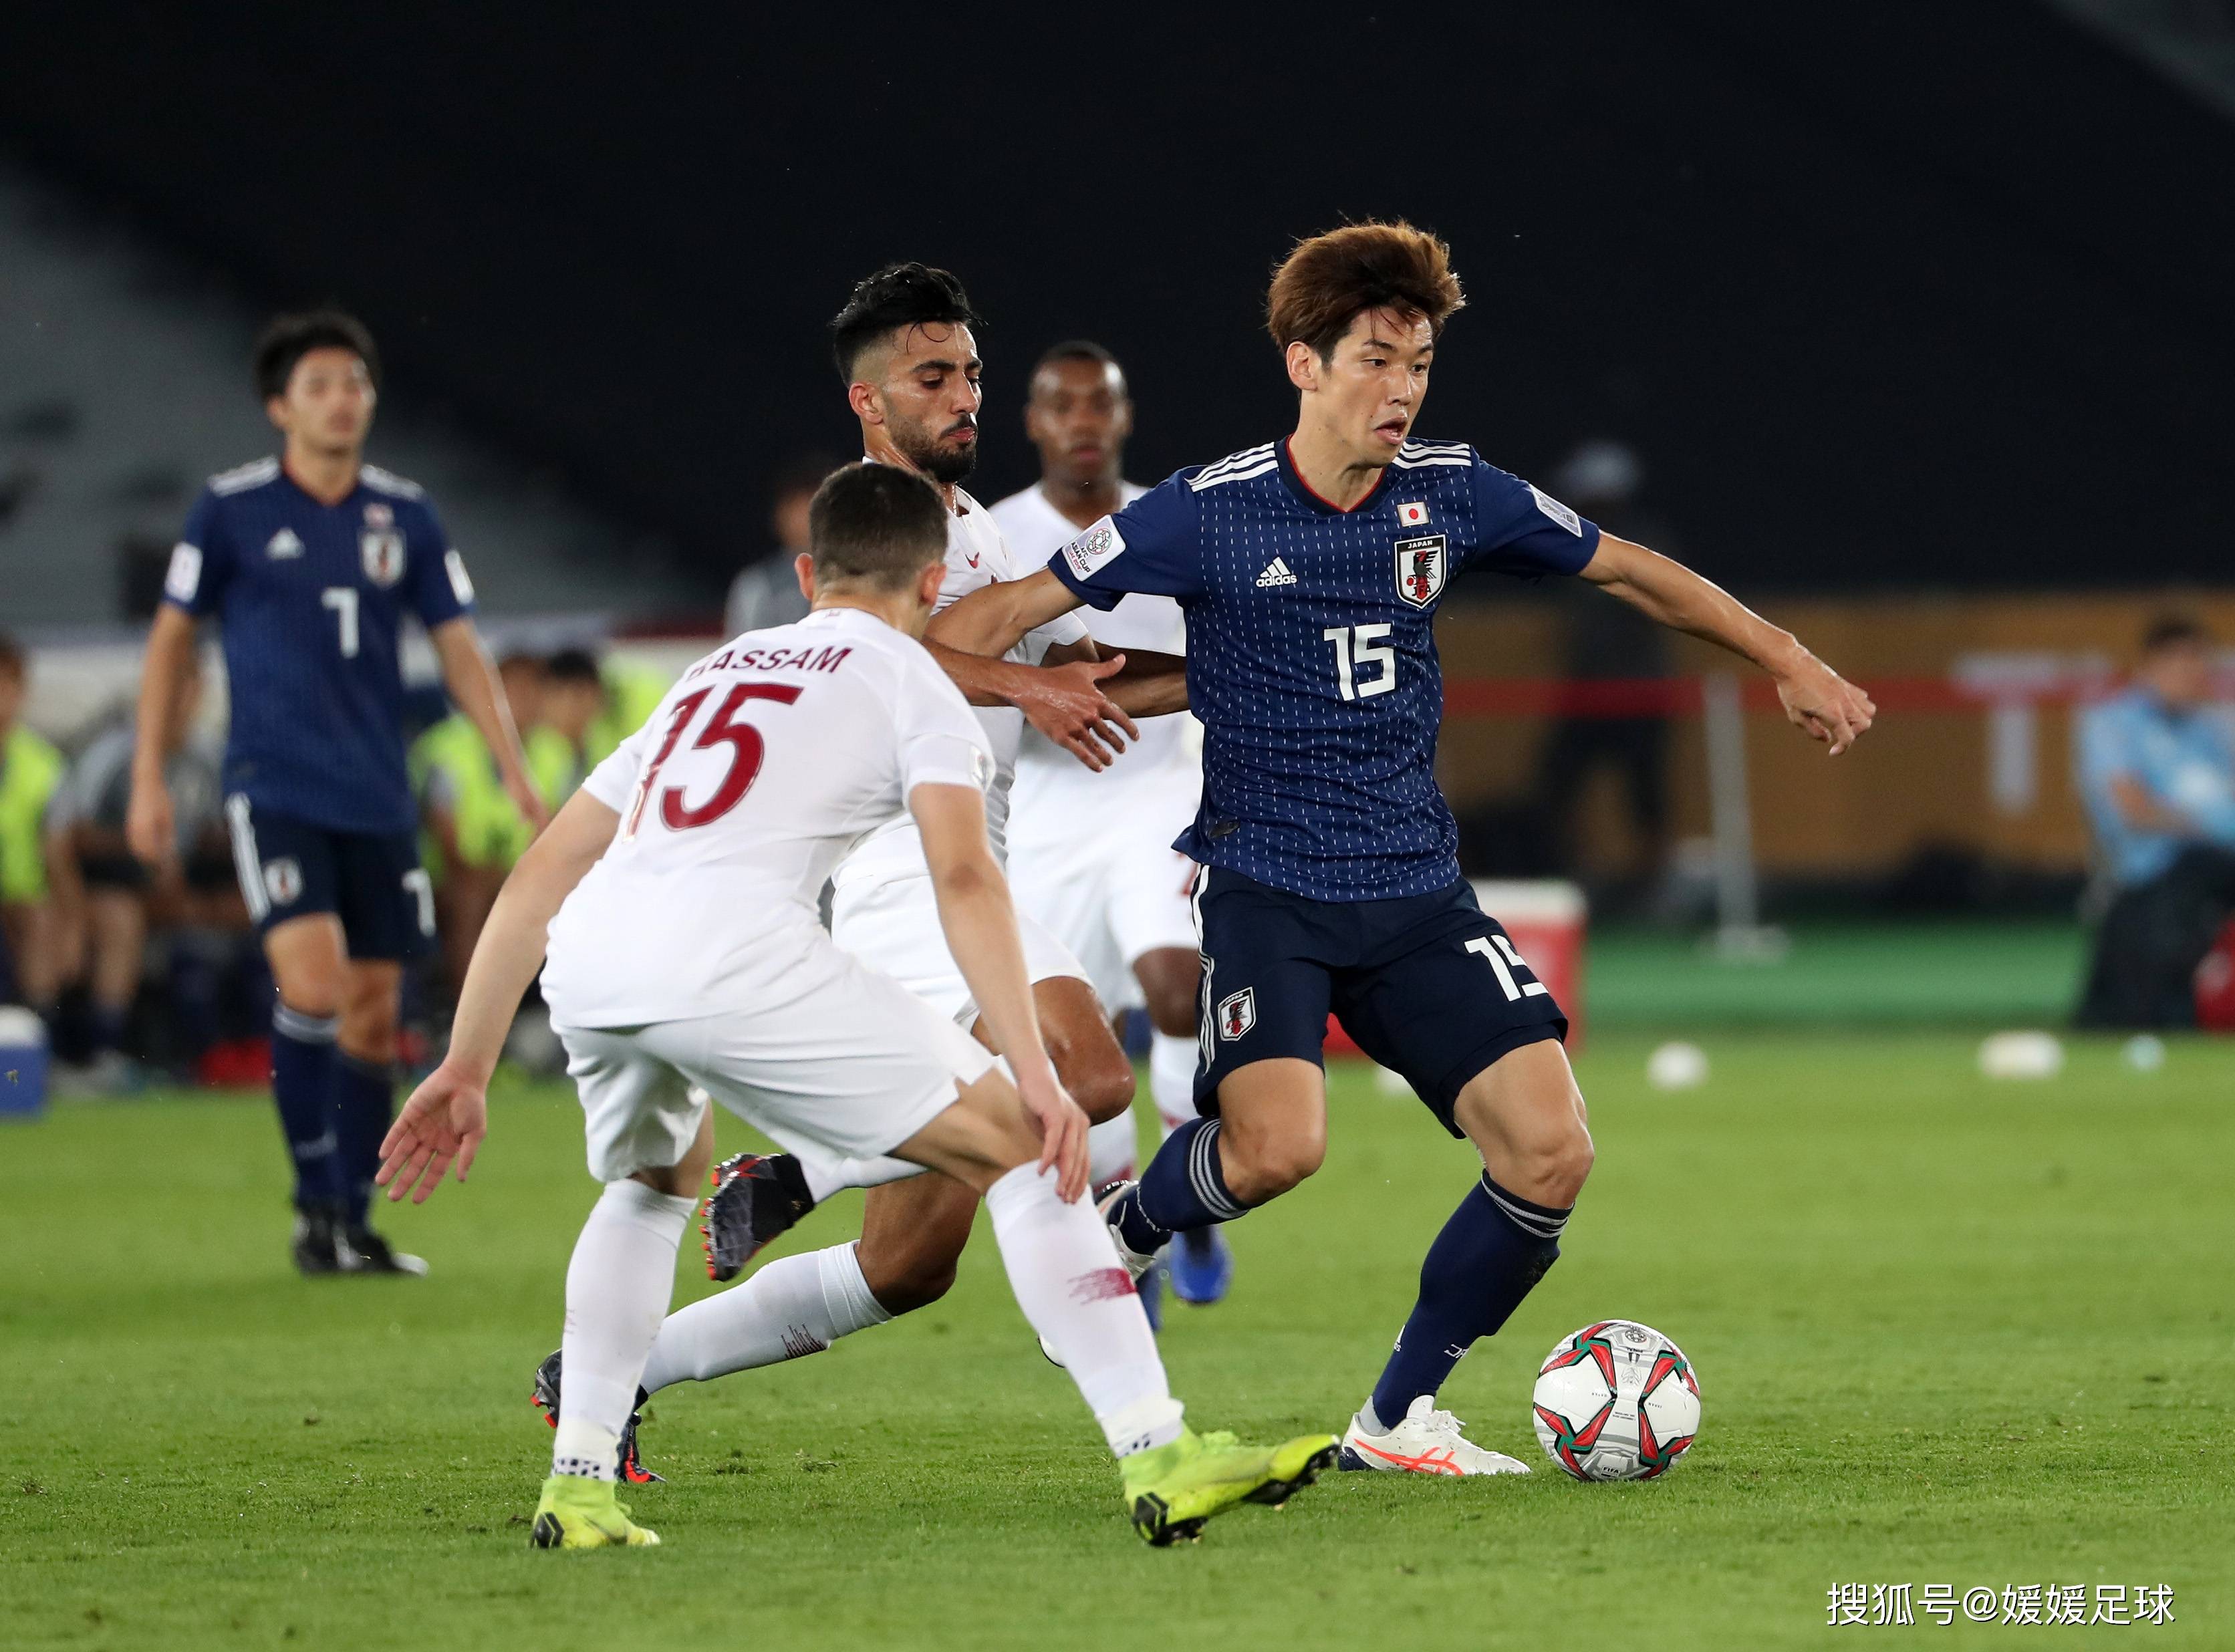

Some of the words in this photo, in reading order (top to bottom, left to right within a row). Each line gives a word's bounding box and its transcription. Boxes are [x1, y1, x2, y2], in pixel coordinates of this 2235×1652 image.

[1071, 542, 1083, 559] ASIAN
[1079, 559, 1091, 573] CUP
[1408, 540, 1432, 549] JAPAN
[1256, 573, 1297, 587] adidas
[321, 586, 360, 659] 7
[1324, 624, 1396, 701] 15
[622, 682, 805, 843] 15
